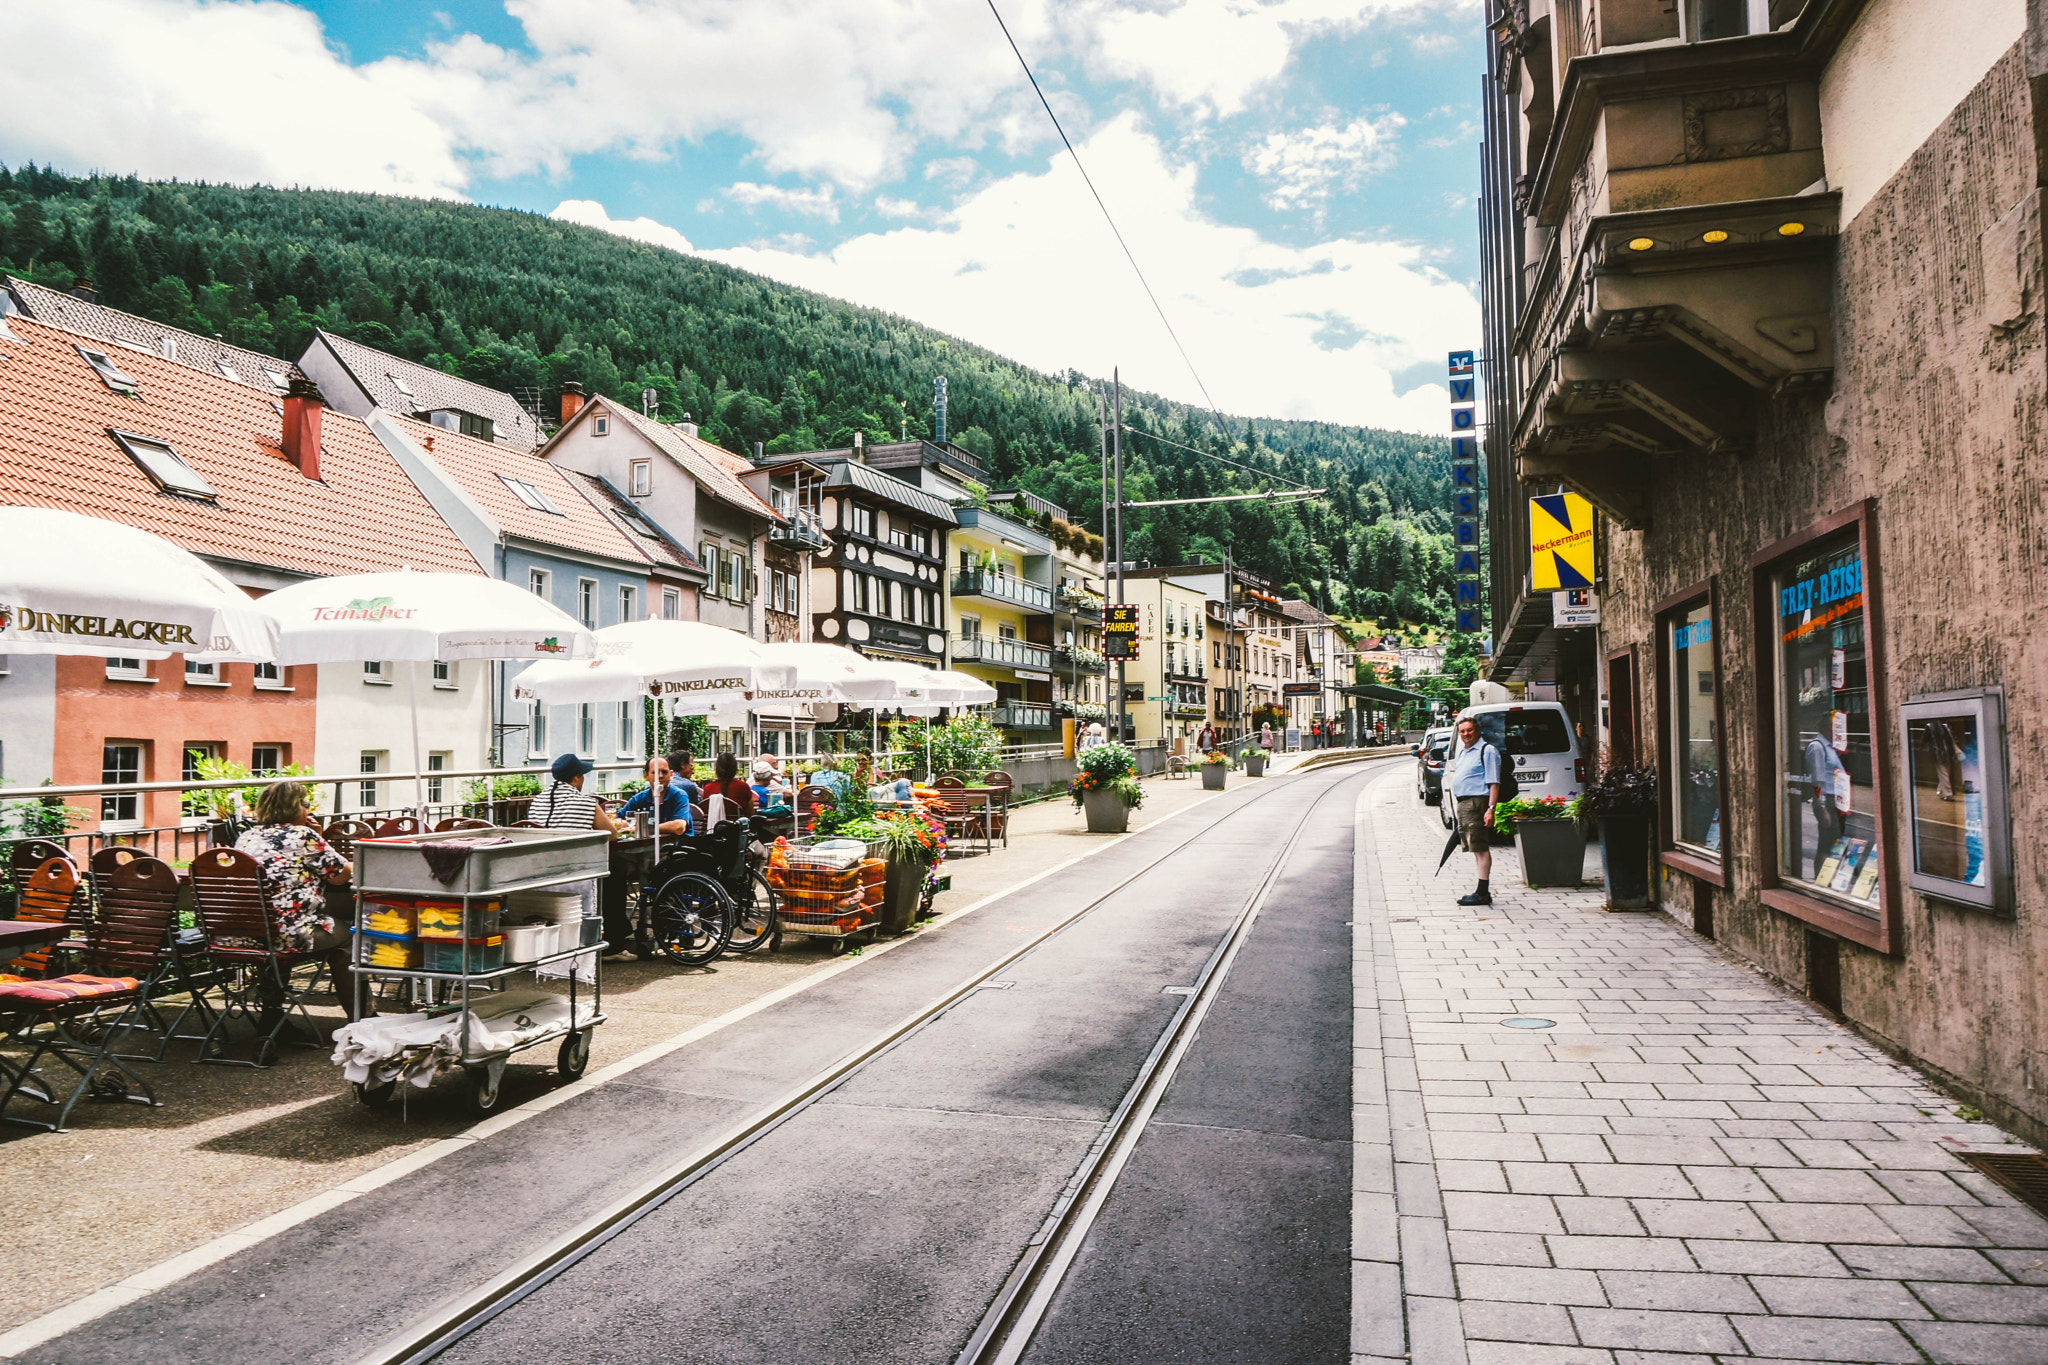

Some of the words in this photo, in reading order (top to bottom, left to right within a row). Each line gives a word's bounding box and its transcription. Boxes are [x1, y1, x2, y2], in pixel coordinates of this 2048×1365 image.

[1453, 380, 1476, 630] VOLKSBANK
[1532, 529, 1592, 554] Neckermann
[312, 605, 418, 621] Teinacher
[1113, 609, 1128, 620] SIE
[1560, 608, 1598, 616] Geldautomat
[16, 606, 198, 646] DINKELACKER
[1105, 622, 1136, 632] FAHREN
[664, 677, 747, 694] DINKELACKER
[756, 689, 823, 699] DINKELACKER
